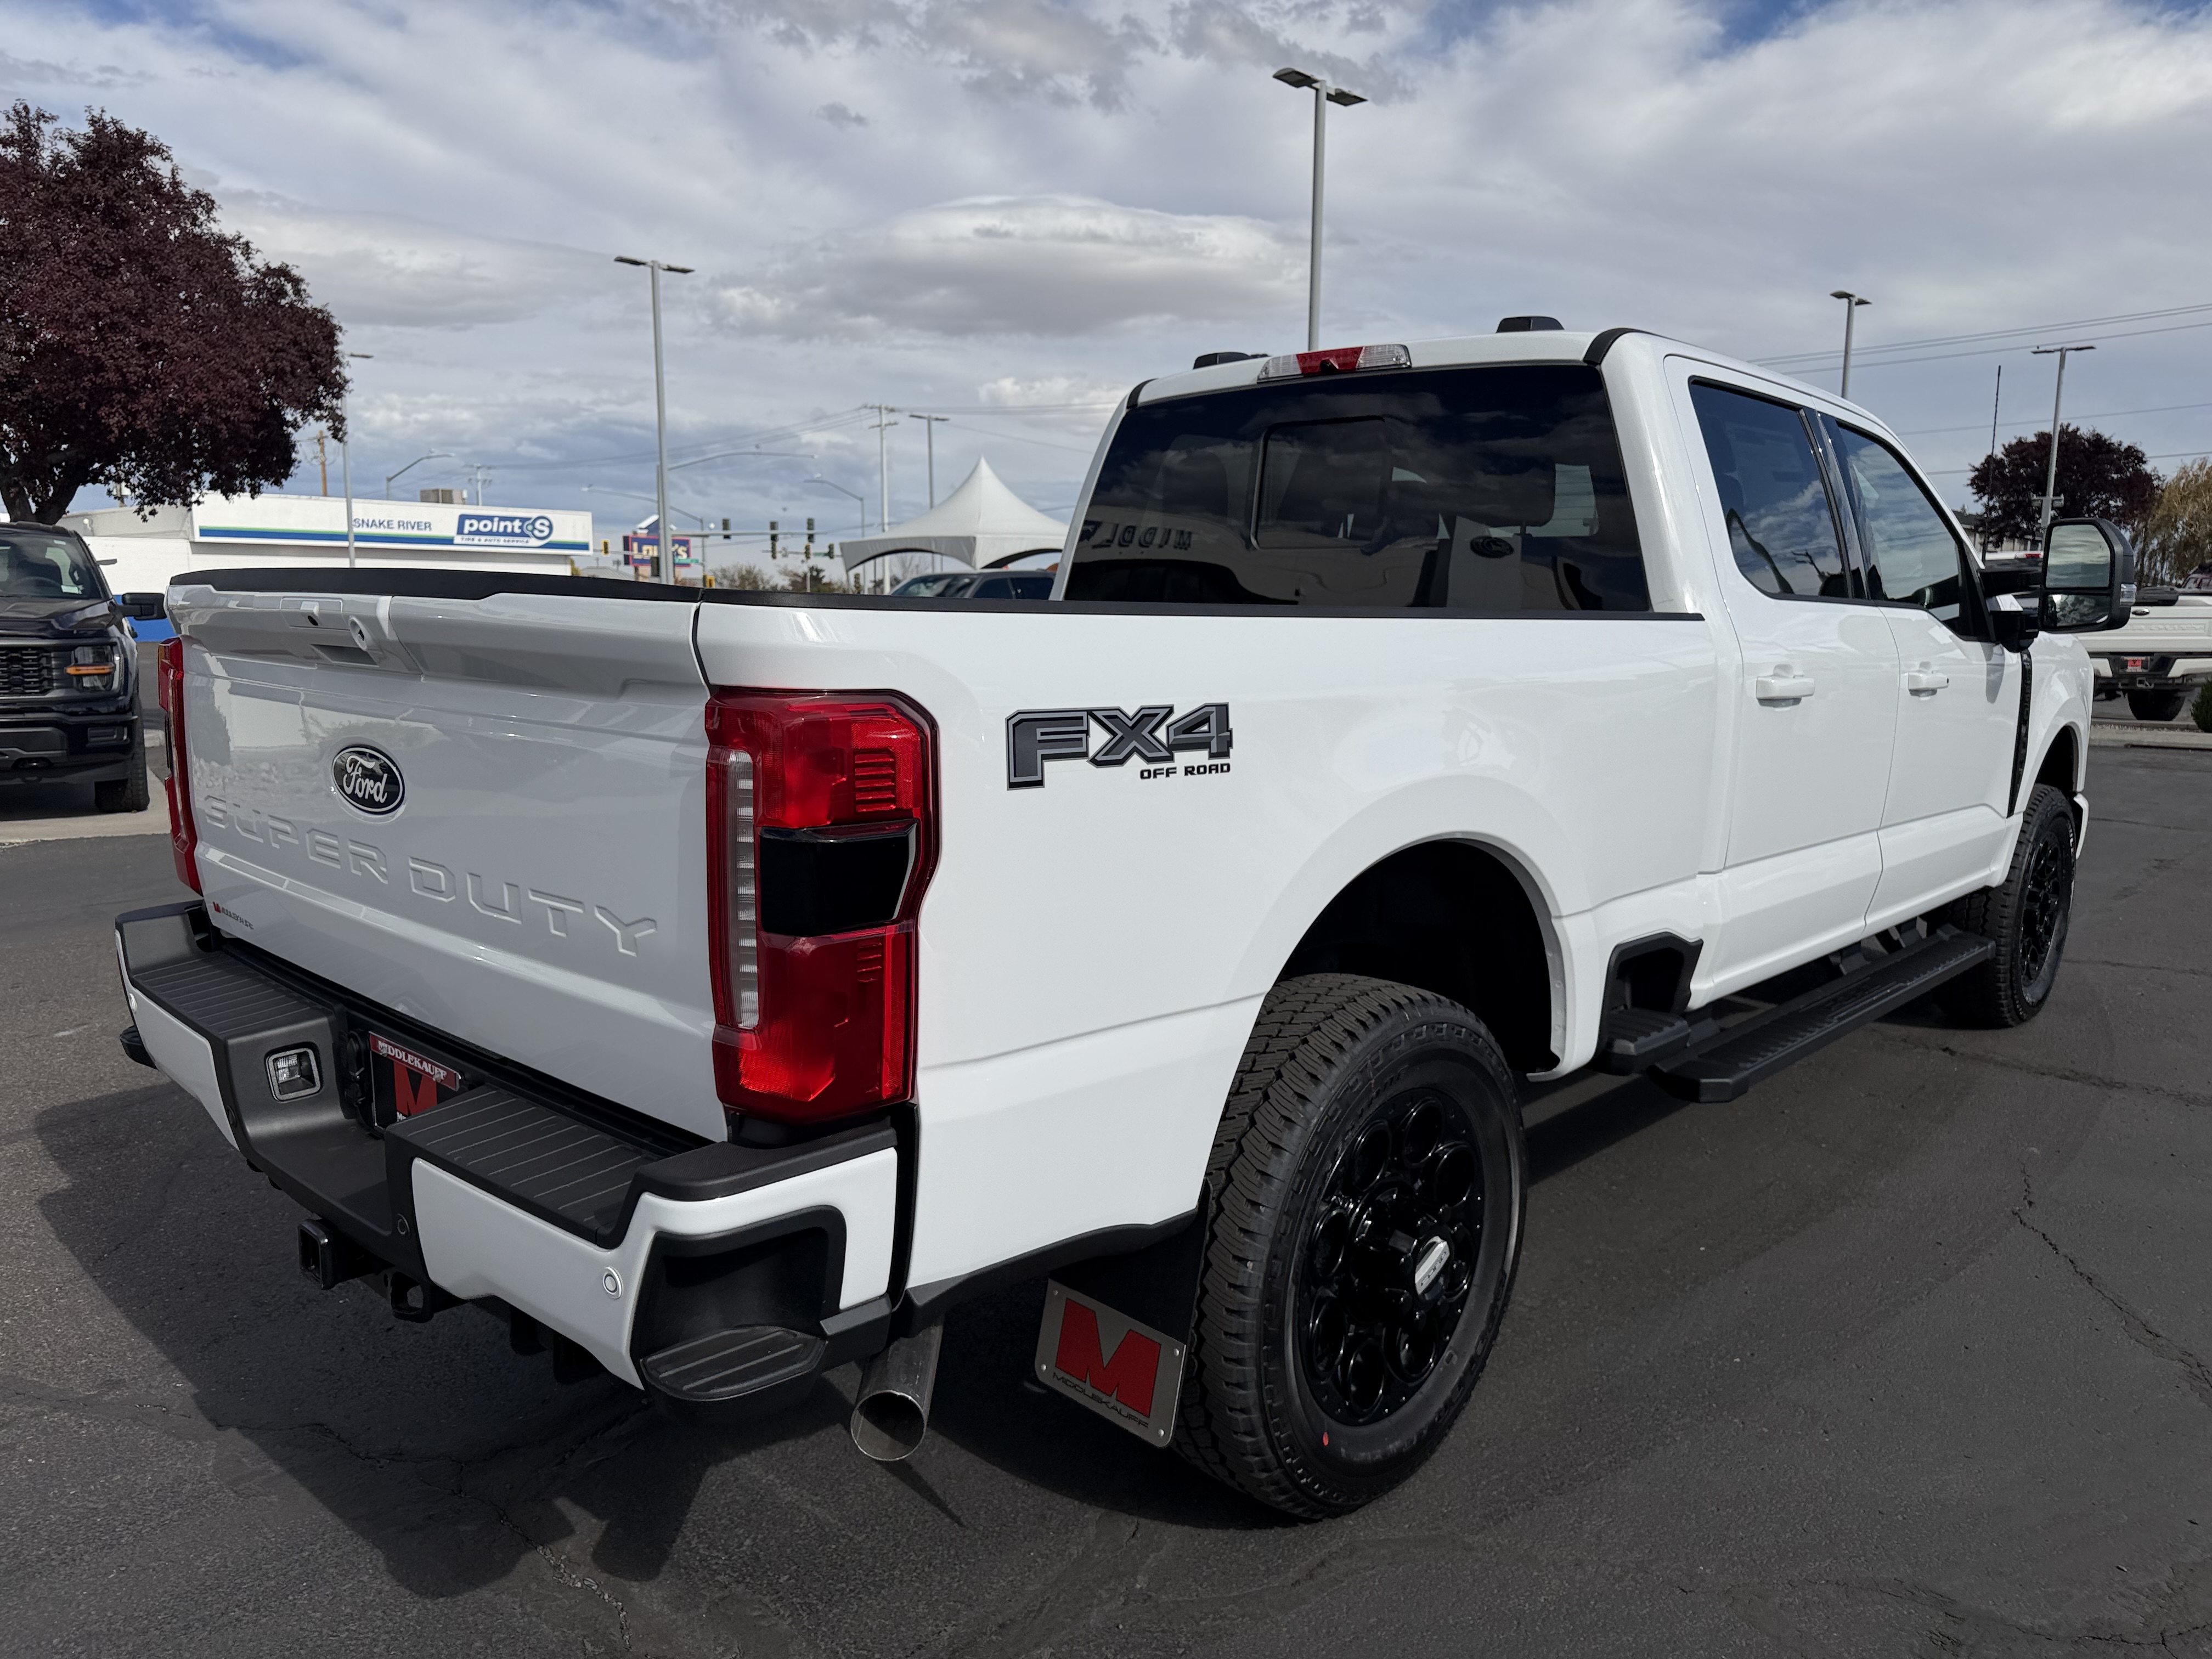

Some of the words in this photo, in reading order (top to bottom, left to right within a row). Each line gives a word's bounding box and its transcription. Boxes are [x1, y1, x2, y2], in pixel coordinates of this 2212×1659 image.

[353, 518, 394, 530] SNAKE
[398, 520, 432, 531] RIVER
[343, 755, 388, 804] Ford
[1005, 702, 1233, 791] FX4
[1139, 766, 1177, 780] OFF
[1184, 763, 1231, 776] ROAD
[205, 795, 388, 884] SUPER
[408, 855, 658, 957] DUTY
[1055, 1297, 1161, 1418] M
